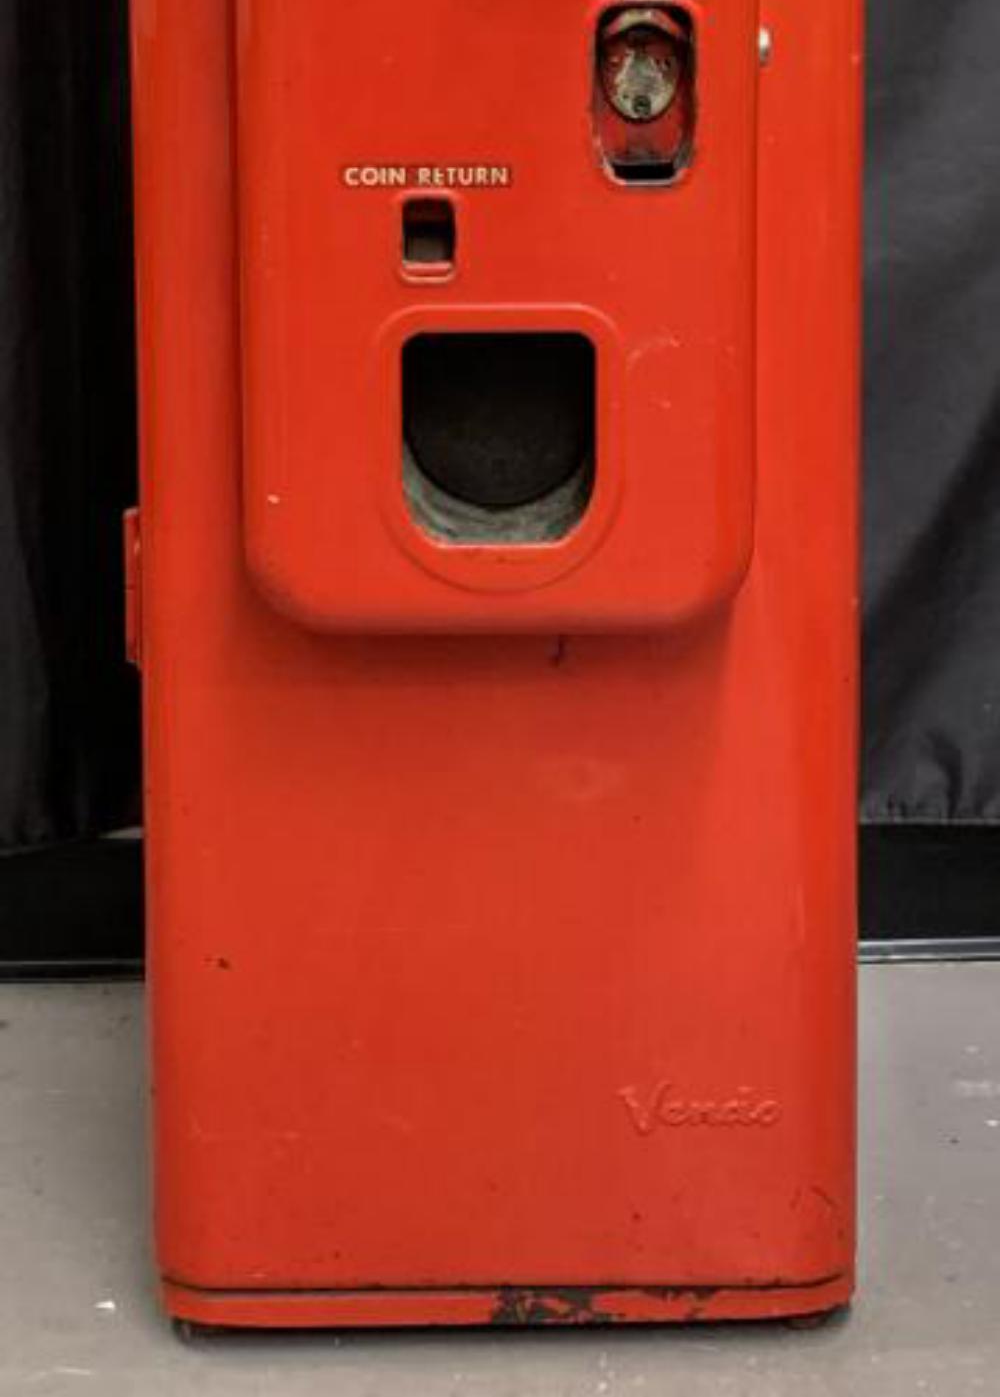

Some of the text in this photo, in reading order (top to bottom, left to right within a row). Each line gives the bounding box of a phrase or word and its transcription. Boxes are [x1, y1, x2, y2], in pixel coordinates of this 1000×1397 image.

[344, 166, 508, 186] COIN RETURN
[615, 1080, 783, 1137] Vendo
